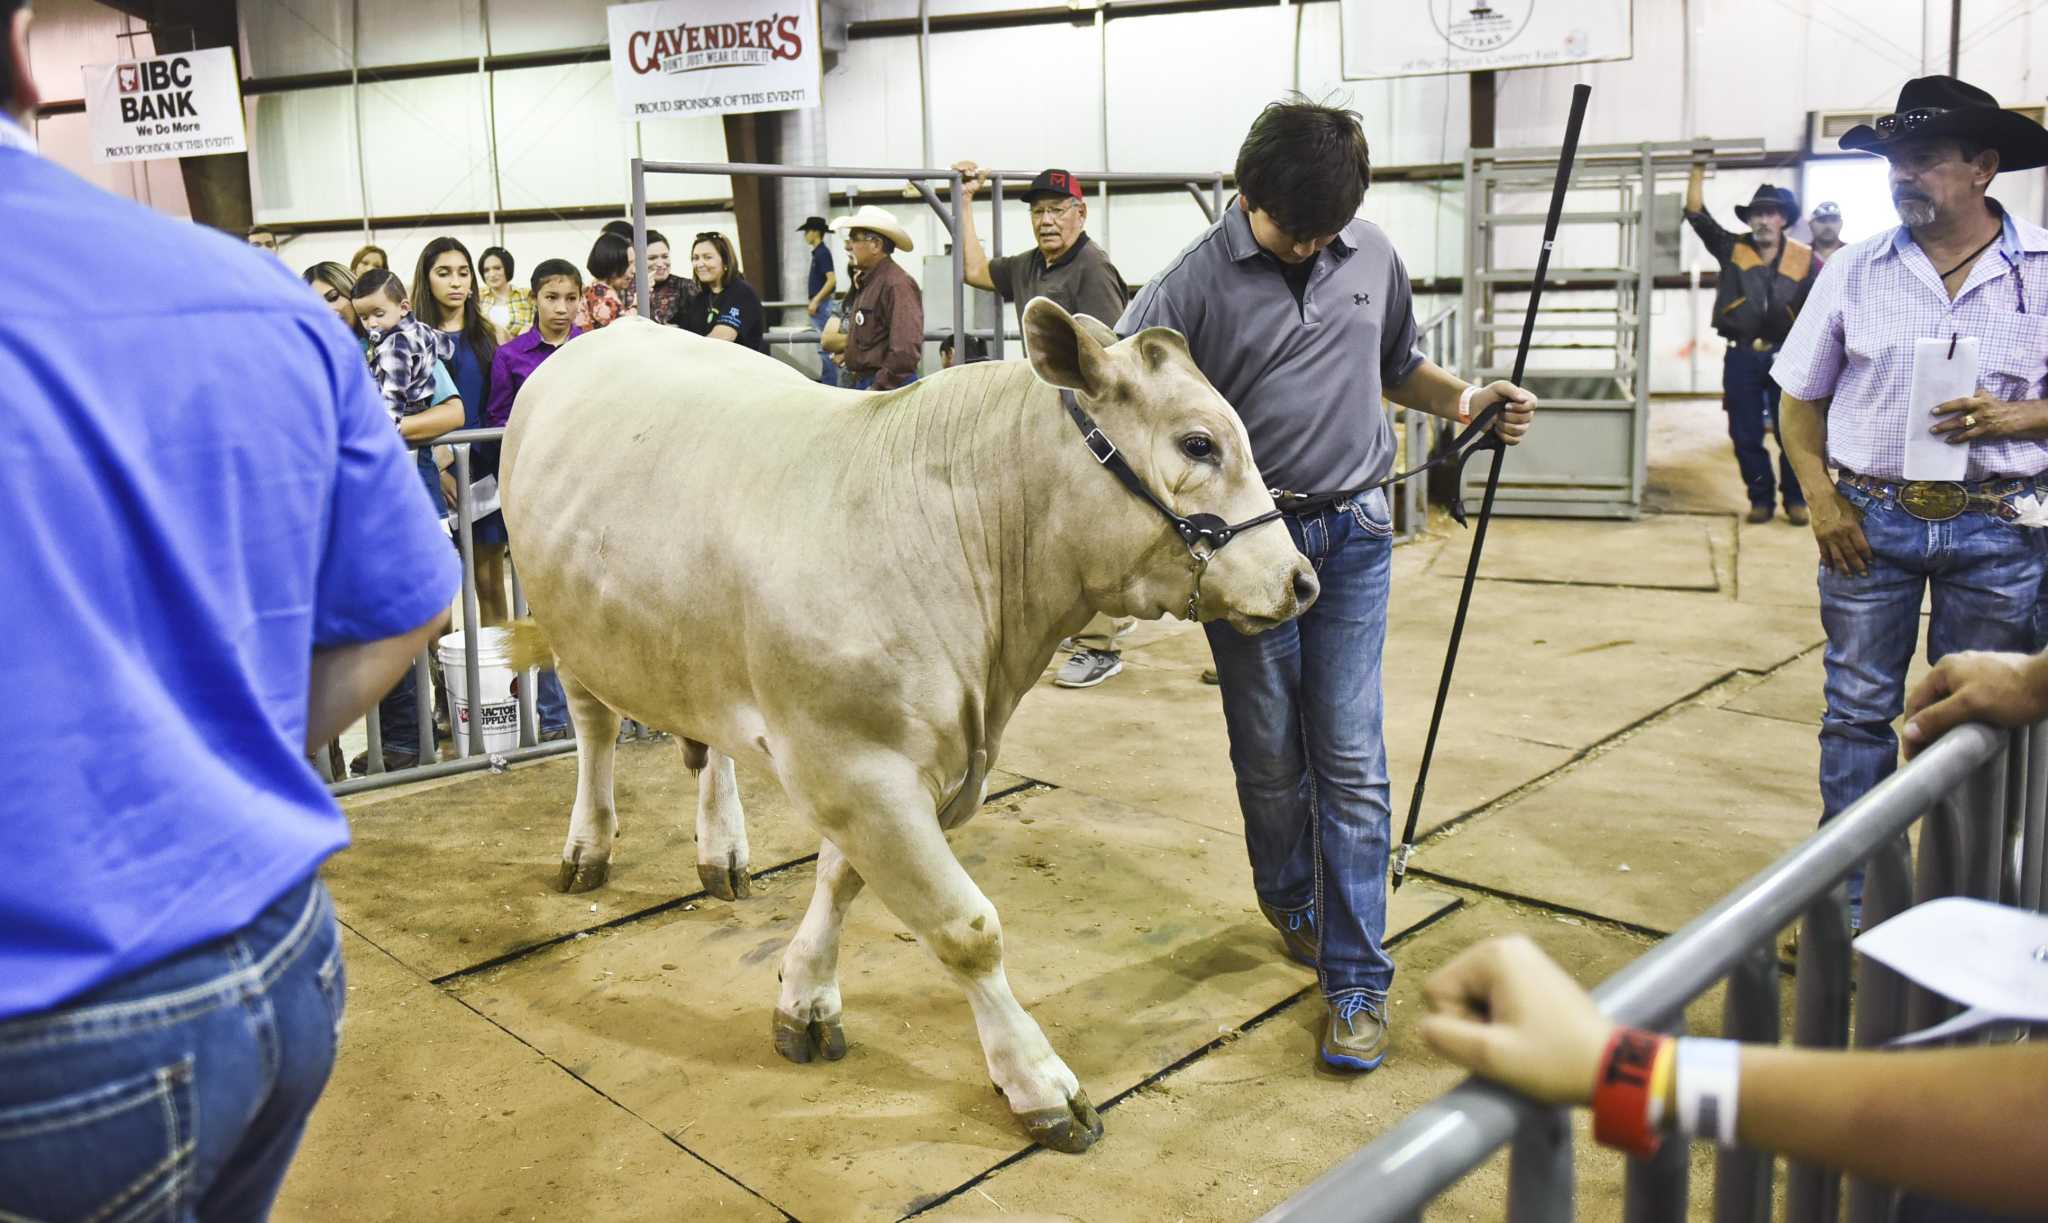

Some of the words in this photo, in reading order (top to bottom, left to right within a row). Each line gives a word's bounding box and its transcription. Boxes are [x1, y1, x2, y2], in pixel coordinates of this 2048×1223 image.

[628, 13, 802, 75] CAVENDER'S
[706, 51, 729, 64] WEAR
[140, 57, 192, 92] IBC
[120, 91, 198, 123] BANK
[635, 99, 671, 114] PROUD
[673, 96, 723, 112] SPONSOR
[726, 95, 742, 107] OF
[742, 93, 765, 105] THIS
[136, 125, 153, 137] We
[156, 124, 170, 135] Do
[172, 122, 200, 134] More
[105, 145, 134, 158] PROUD
[480, 705, 517, 717] RACTOR
